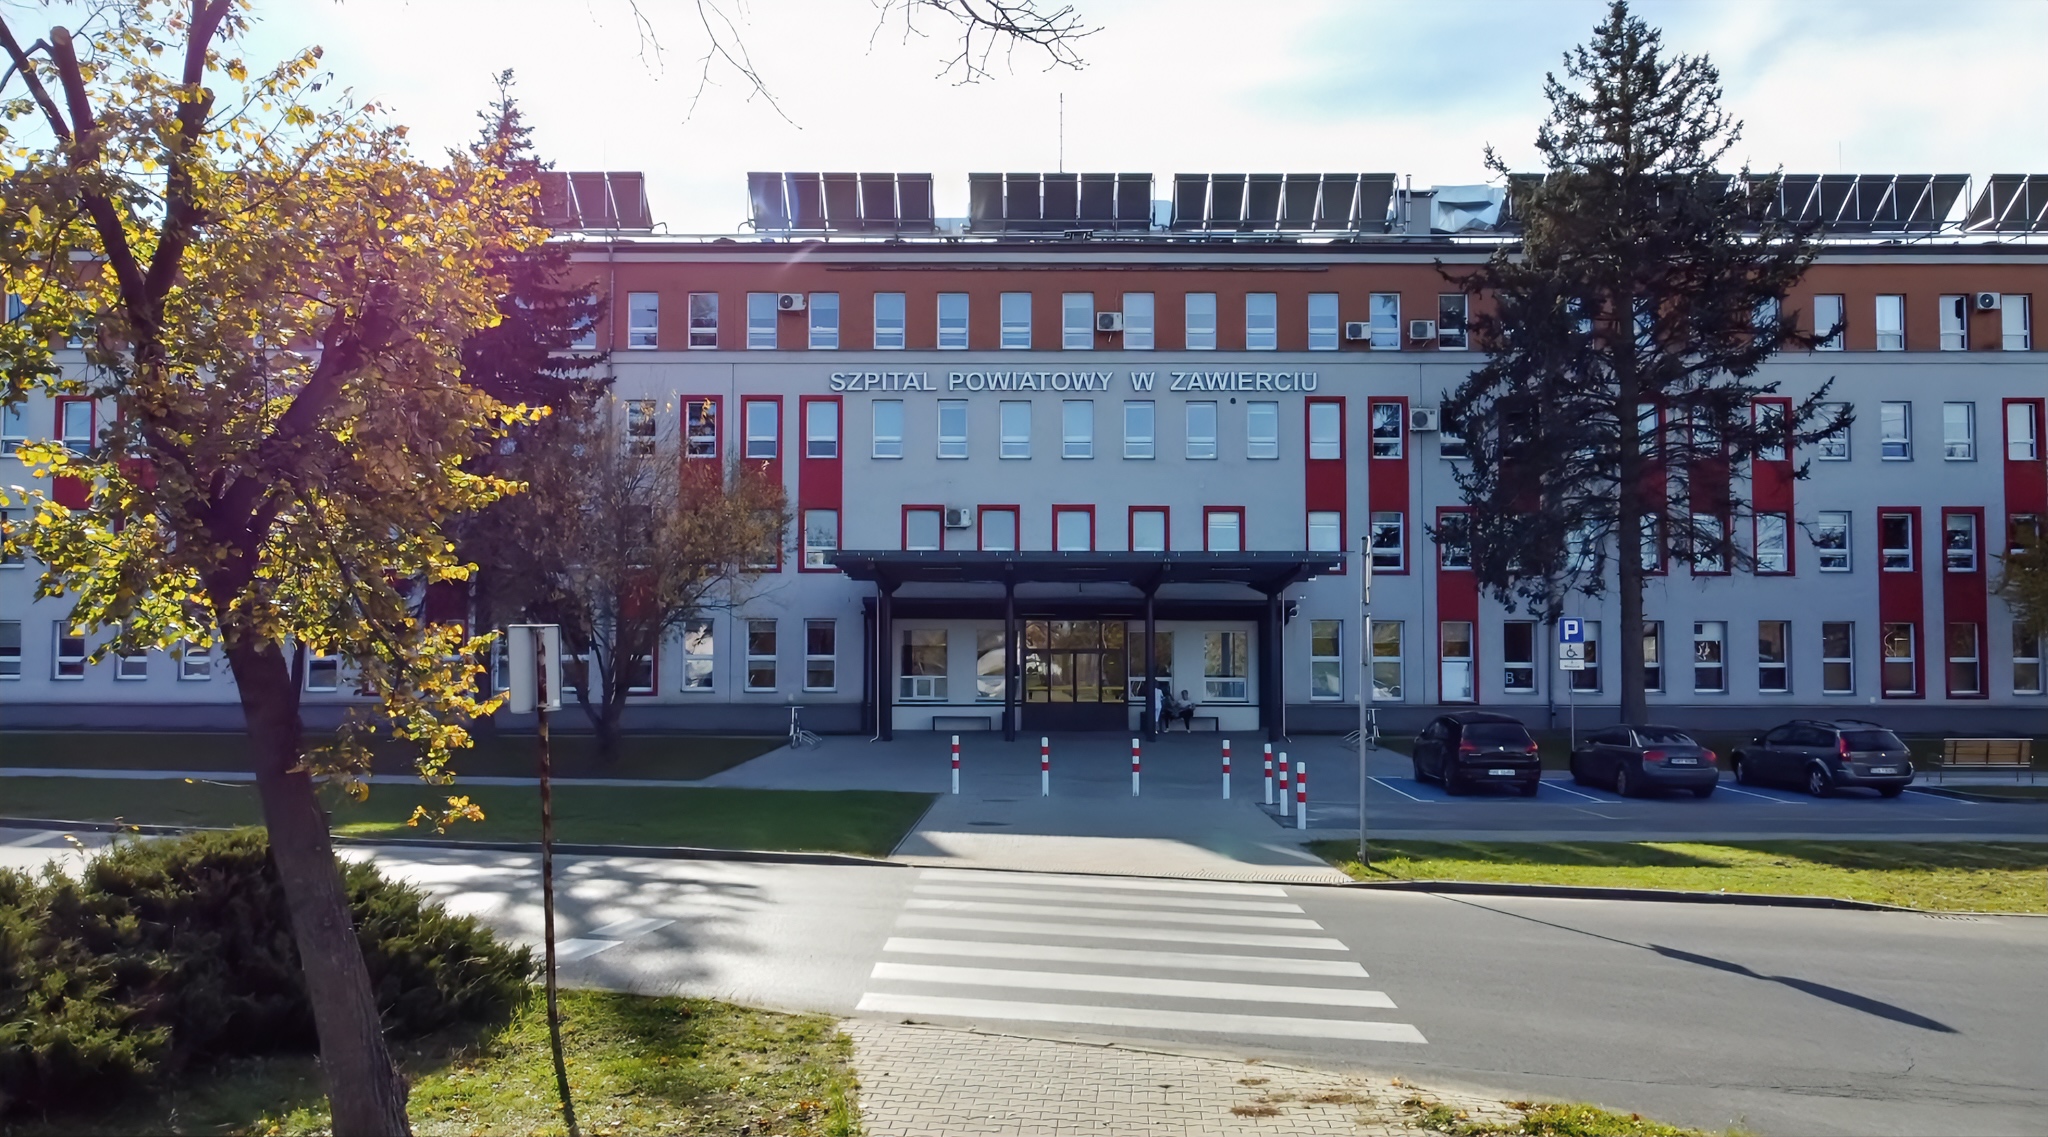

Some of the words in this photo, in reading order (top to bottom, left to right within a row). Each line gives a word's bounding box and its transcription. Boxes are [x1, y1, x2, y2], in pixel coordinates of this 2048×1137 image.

[830, 372, 937, 391] SZPITAL
[949, 372, 1113, 391] POWIATOWY
[1130, 372, 1155, 391] W
[1170, 372, 1318, 391] ZAWIERCIU
[1564, 620, 1579, 640] P
